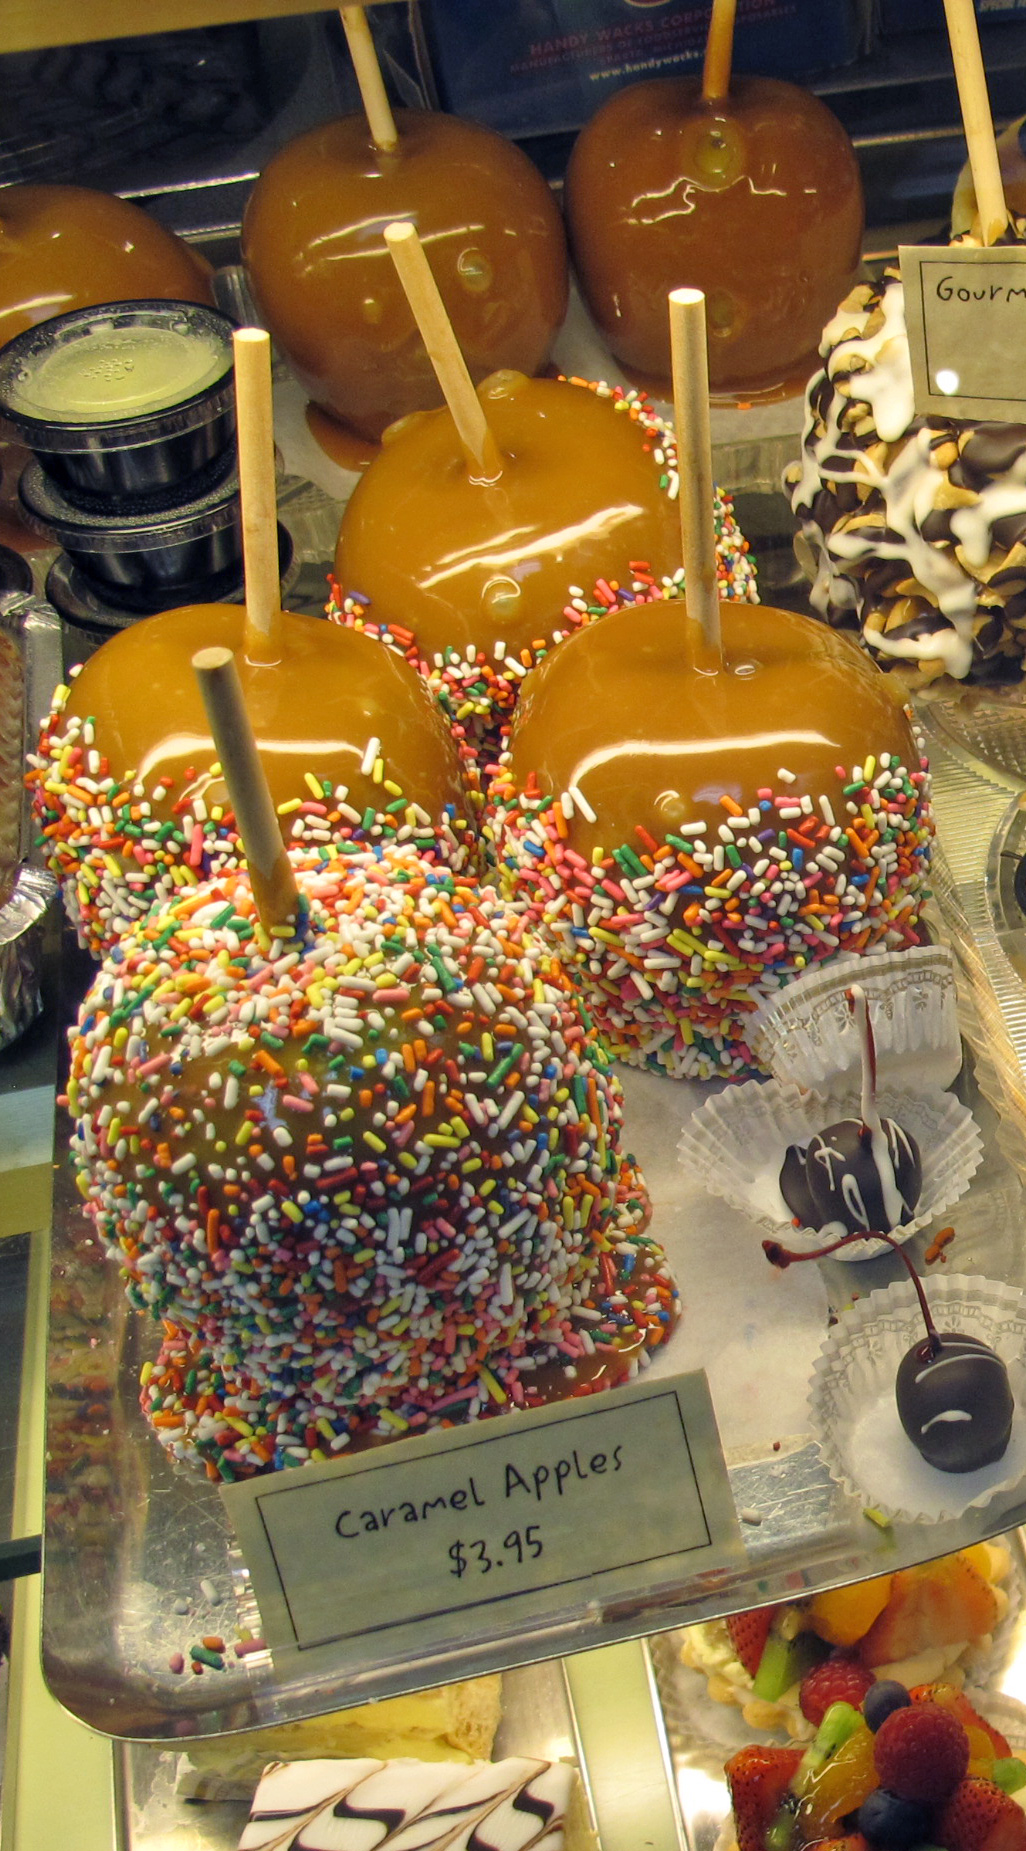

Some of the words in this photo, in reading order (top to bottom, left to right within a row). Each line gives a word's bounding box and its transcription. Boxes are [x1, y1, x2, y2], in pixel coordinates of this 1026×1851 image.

[528, 33, 588, 56] HANDY
[596, 20, 654, 41] WACKS
[335, 1477, 486, 1539] Caramel
[504, 1444, 623, 1501] Apples
[448, 1525, 544, 1578] $3.95
